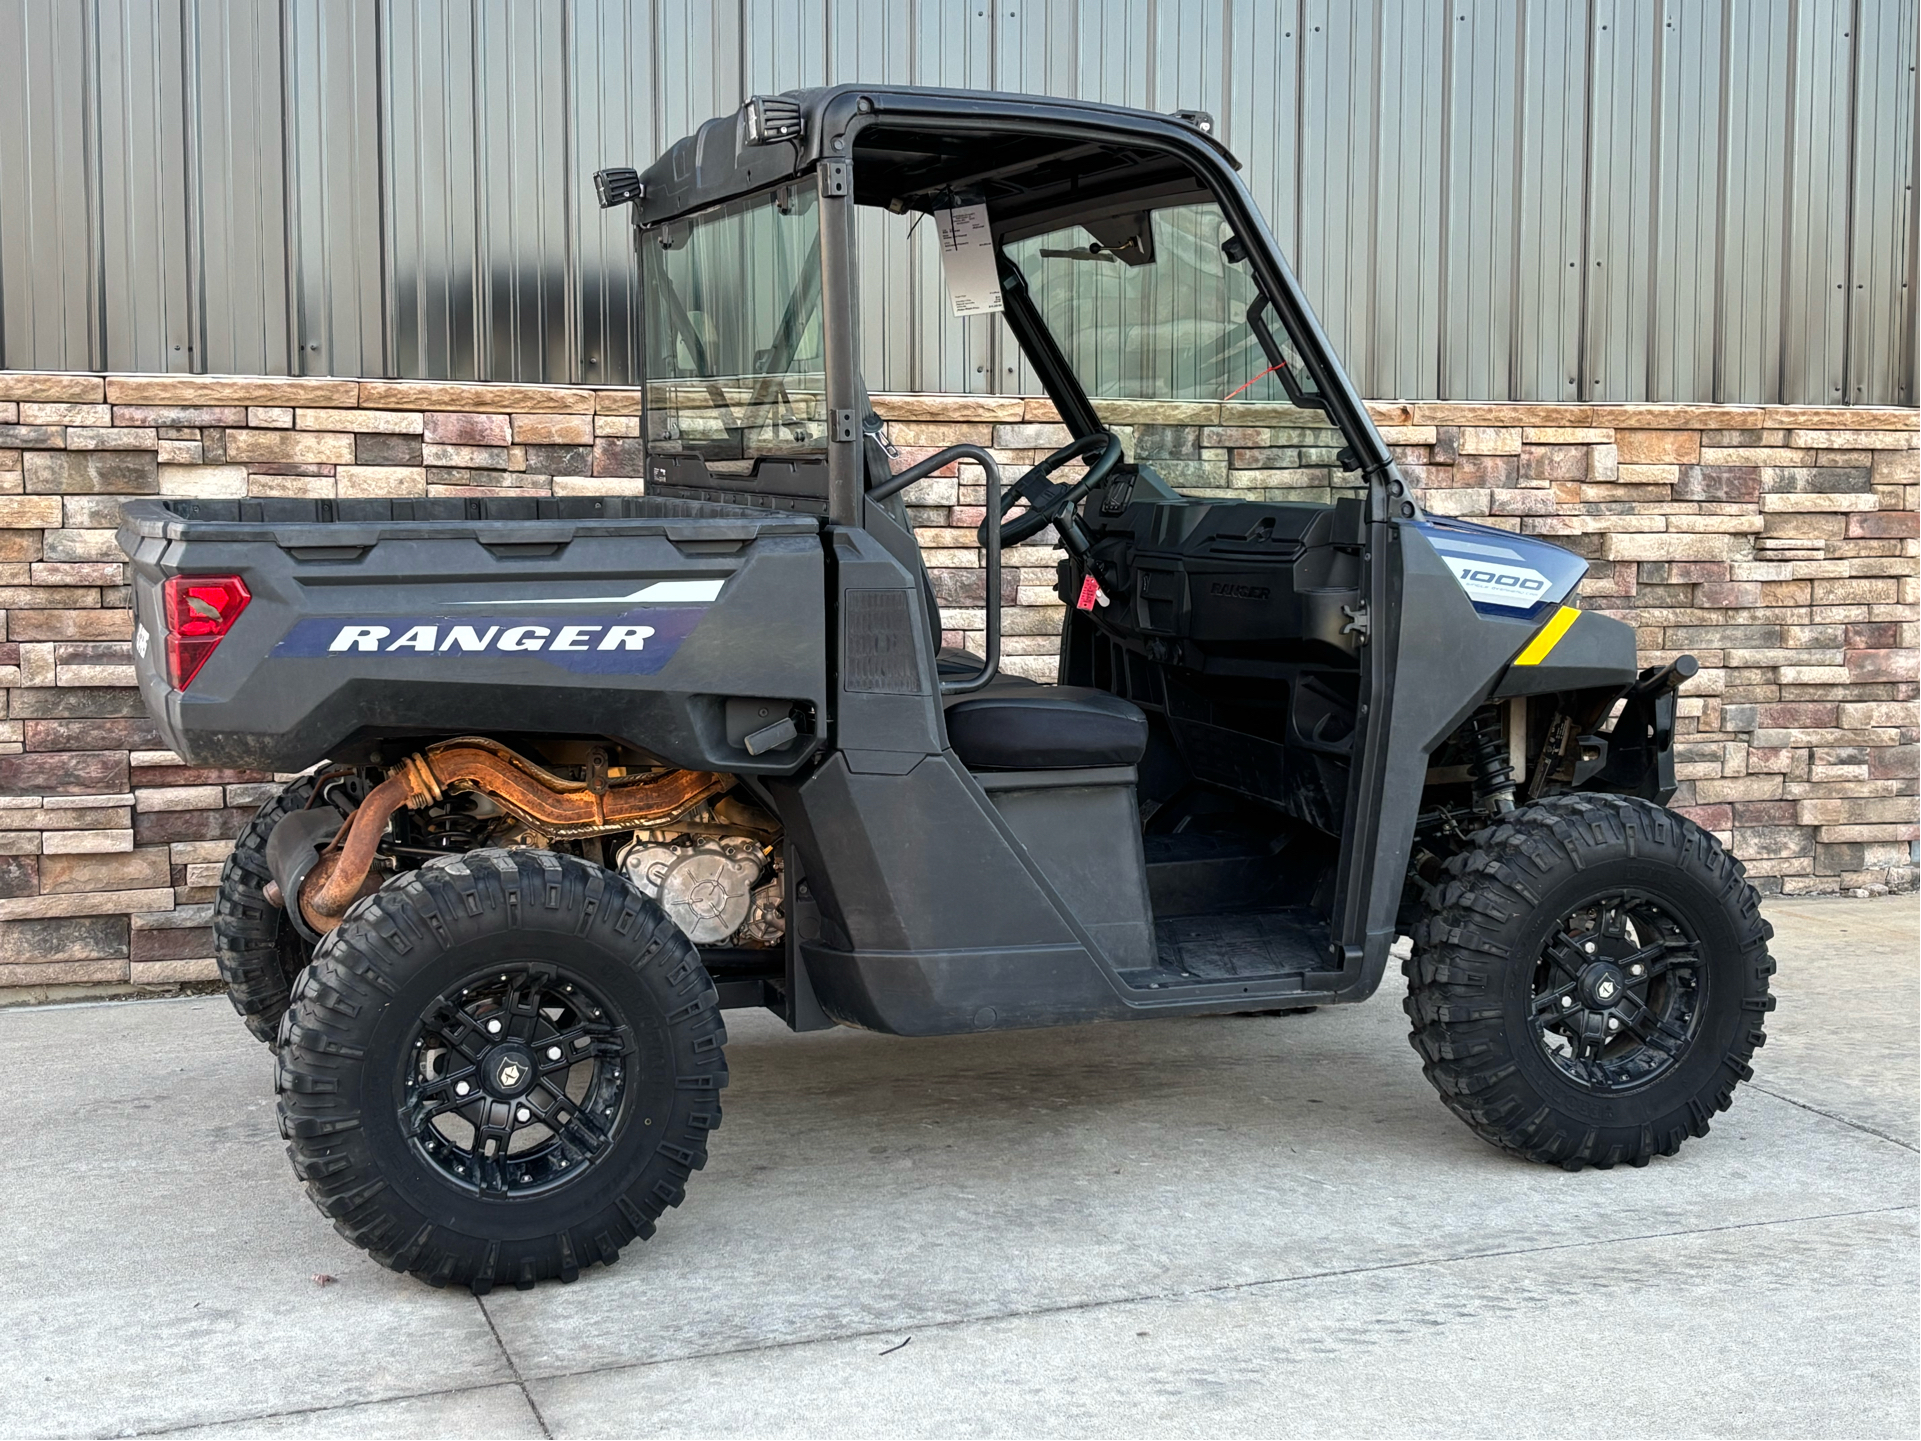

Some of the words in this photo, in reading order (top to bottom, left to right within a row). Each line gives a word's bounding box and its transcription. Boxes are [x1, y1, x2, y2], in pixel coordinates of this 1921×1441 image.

[1460, 569, 1544, 590] 1000
[1211, 583, 1270, 600] RANGER
[329, 625, 656, 652] RANGER
